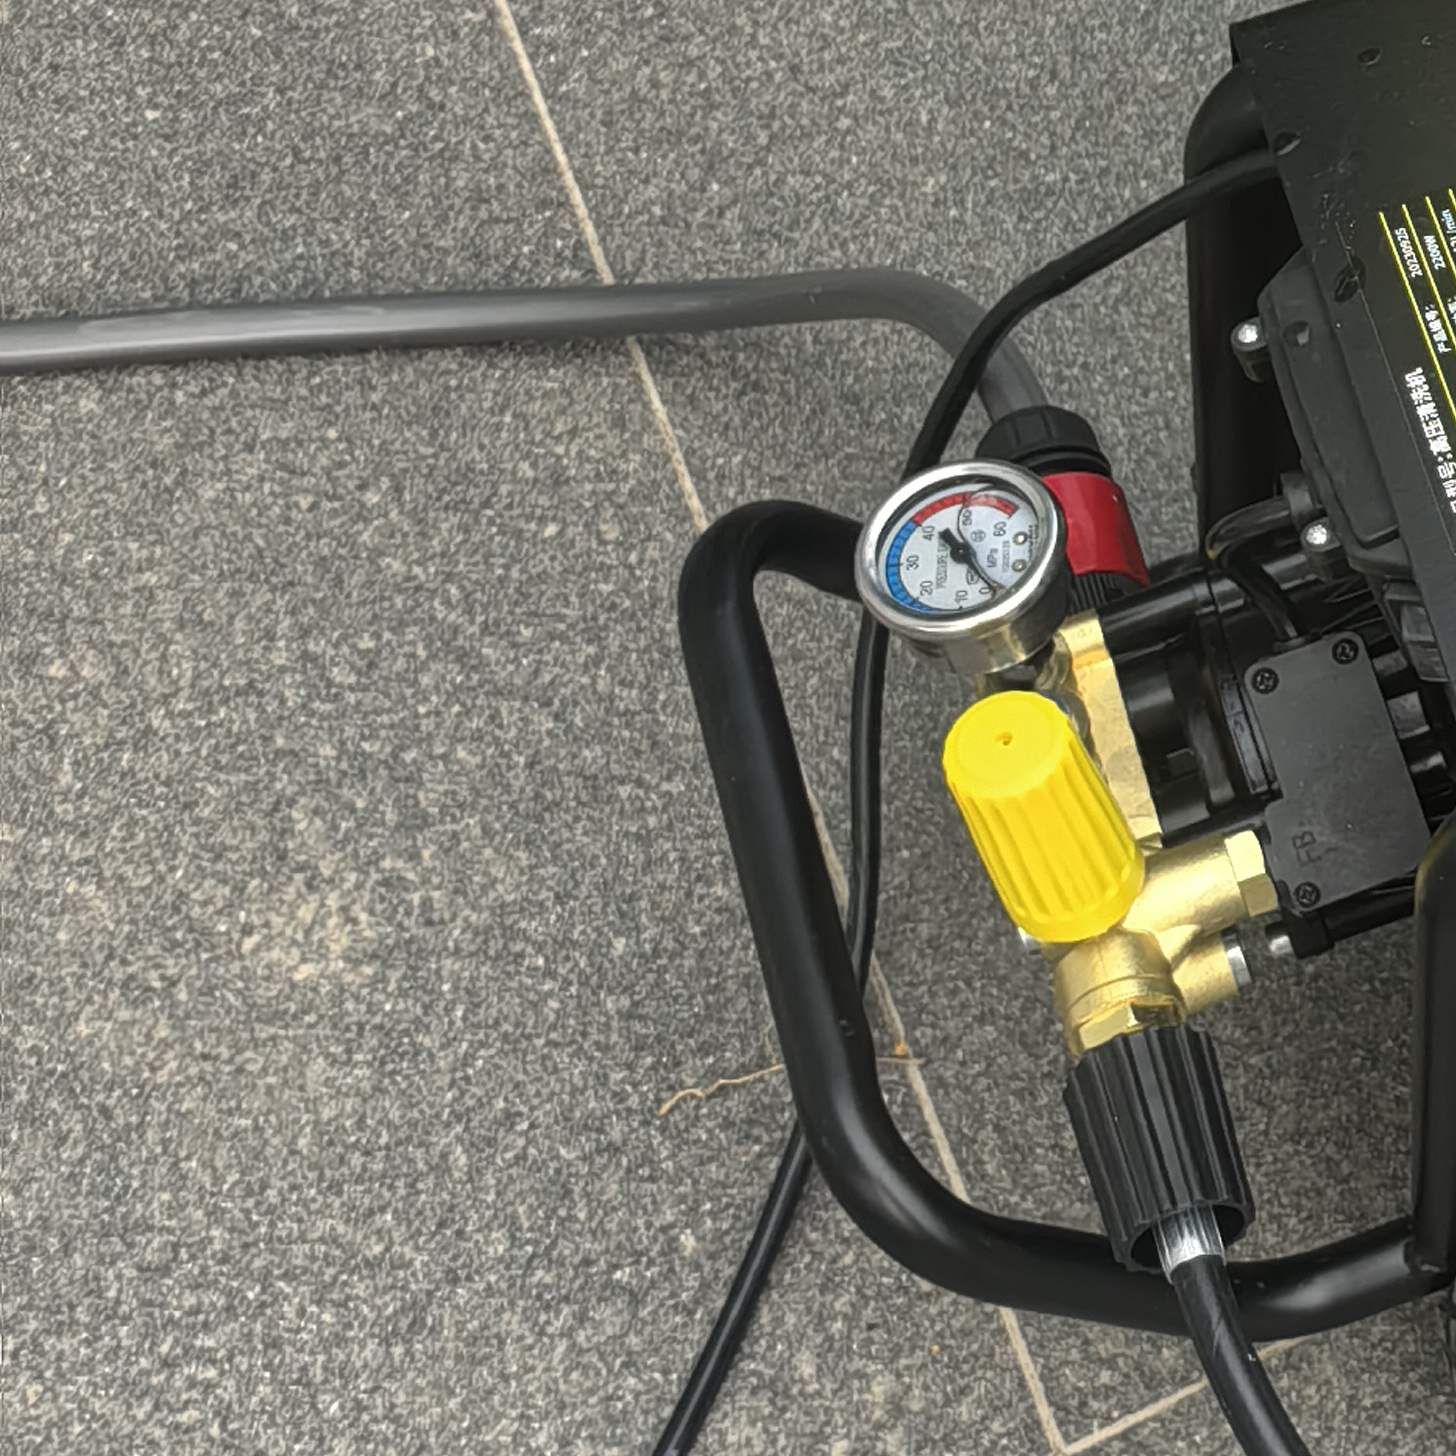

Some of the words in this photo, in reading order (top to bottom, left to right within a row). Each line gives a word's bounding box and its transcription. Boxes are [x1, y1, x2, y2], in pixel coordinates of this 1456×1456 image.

[922, 525, 935, 541] 40
[906, 554, 919, 570] 30
[920, 580, 933, 596] 20
[955, 590, 968, 604] 10
